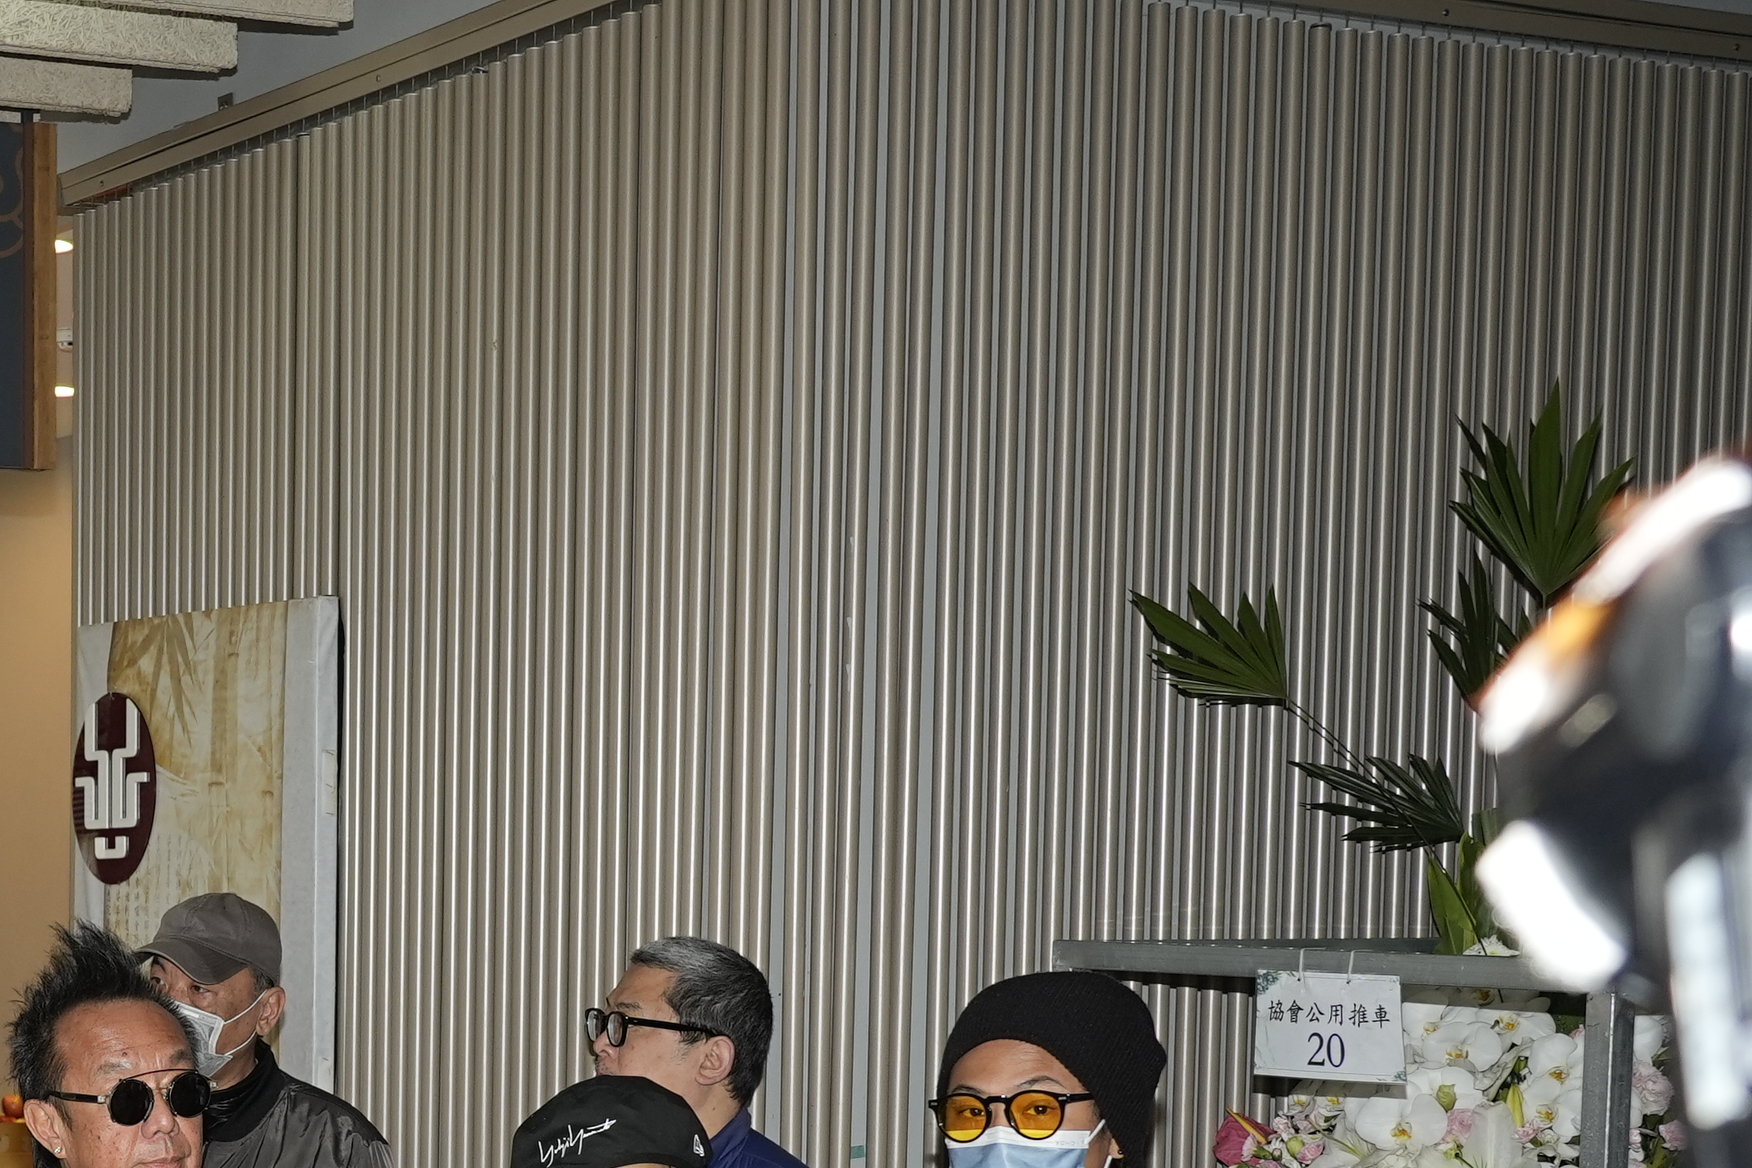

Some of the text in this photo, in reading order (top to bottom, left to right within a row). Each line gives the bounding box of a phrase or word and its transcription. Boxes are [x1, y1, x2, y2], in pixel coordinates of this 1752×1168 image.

[1268, 1000, 1391, 1029] 協會公用推車
[1307, 1032, 1346, 1068] 20
